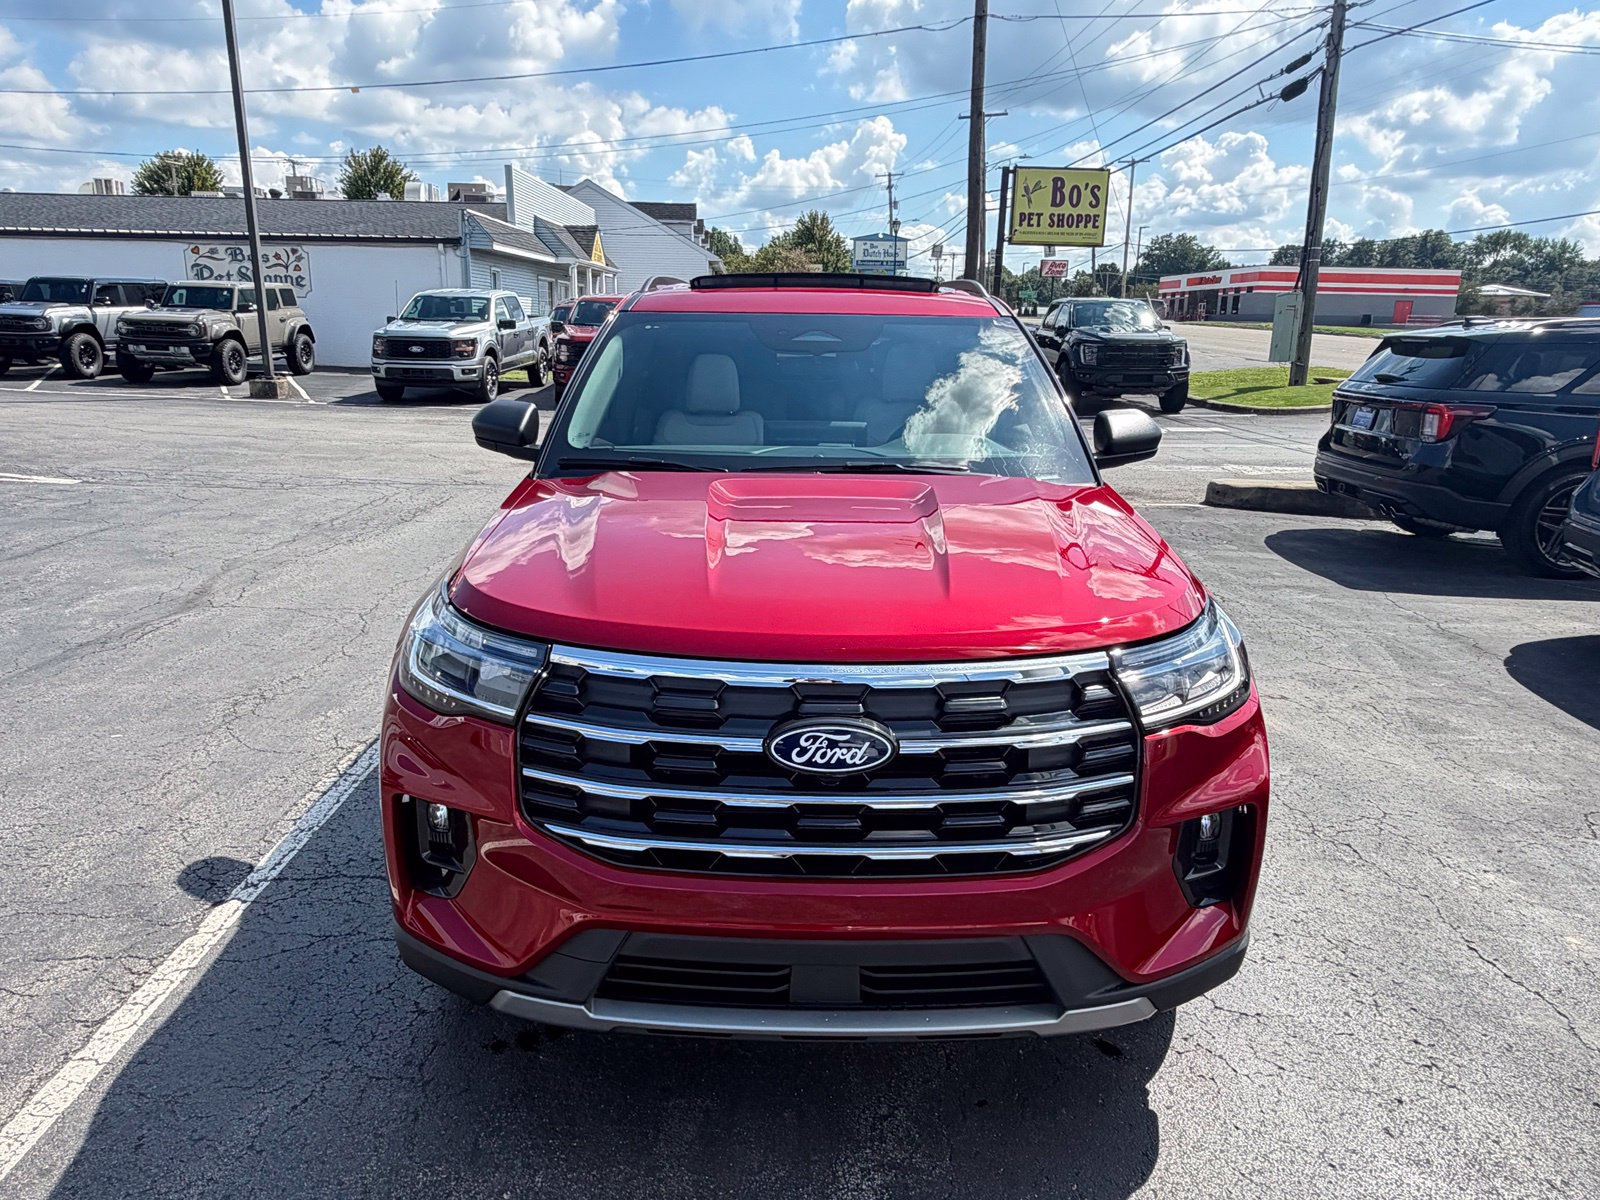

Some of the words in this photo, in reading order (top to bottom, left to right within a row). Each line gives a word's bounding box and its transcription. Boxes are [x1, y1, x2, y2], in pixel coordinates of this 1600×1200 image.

[1050, 176, 1101, 209] Bo's
[1018, 212, 1044, 228] PET
[1048, 212, 1100, 229] SHOPPE
[236, 265, 306, 287] Soppe
[791, 732, 870, 764] Ford
